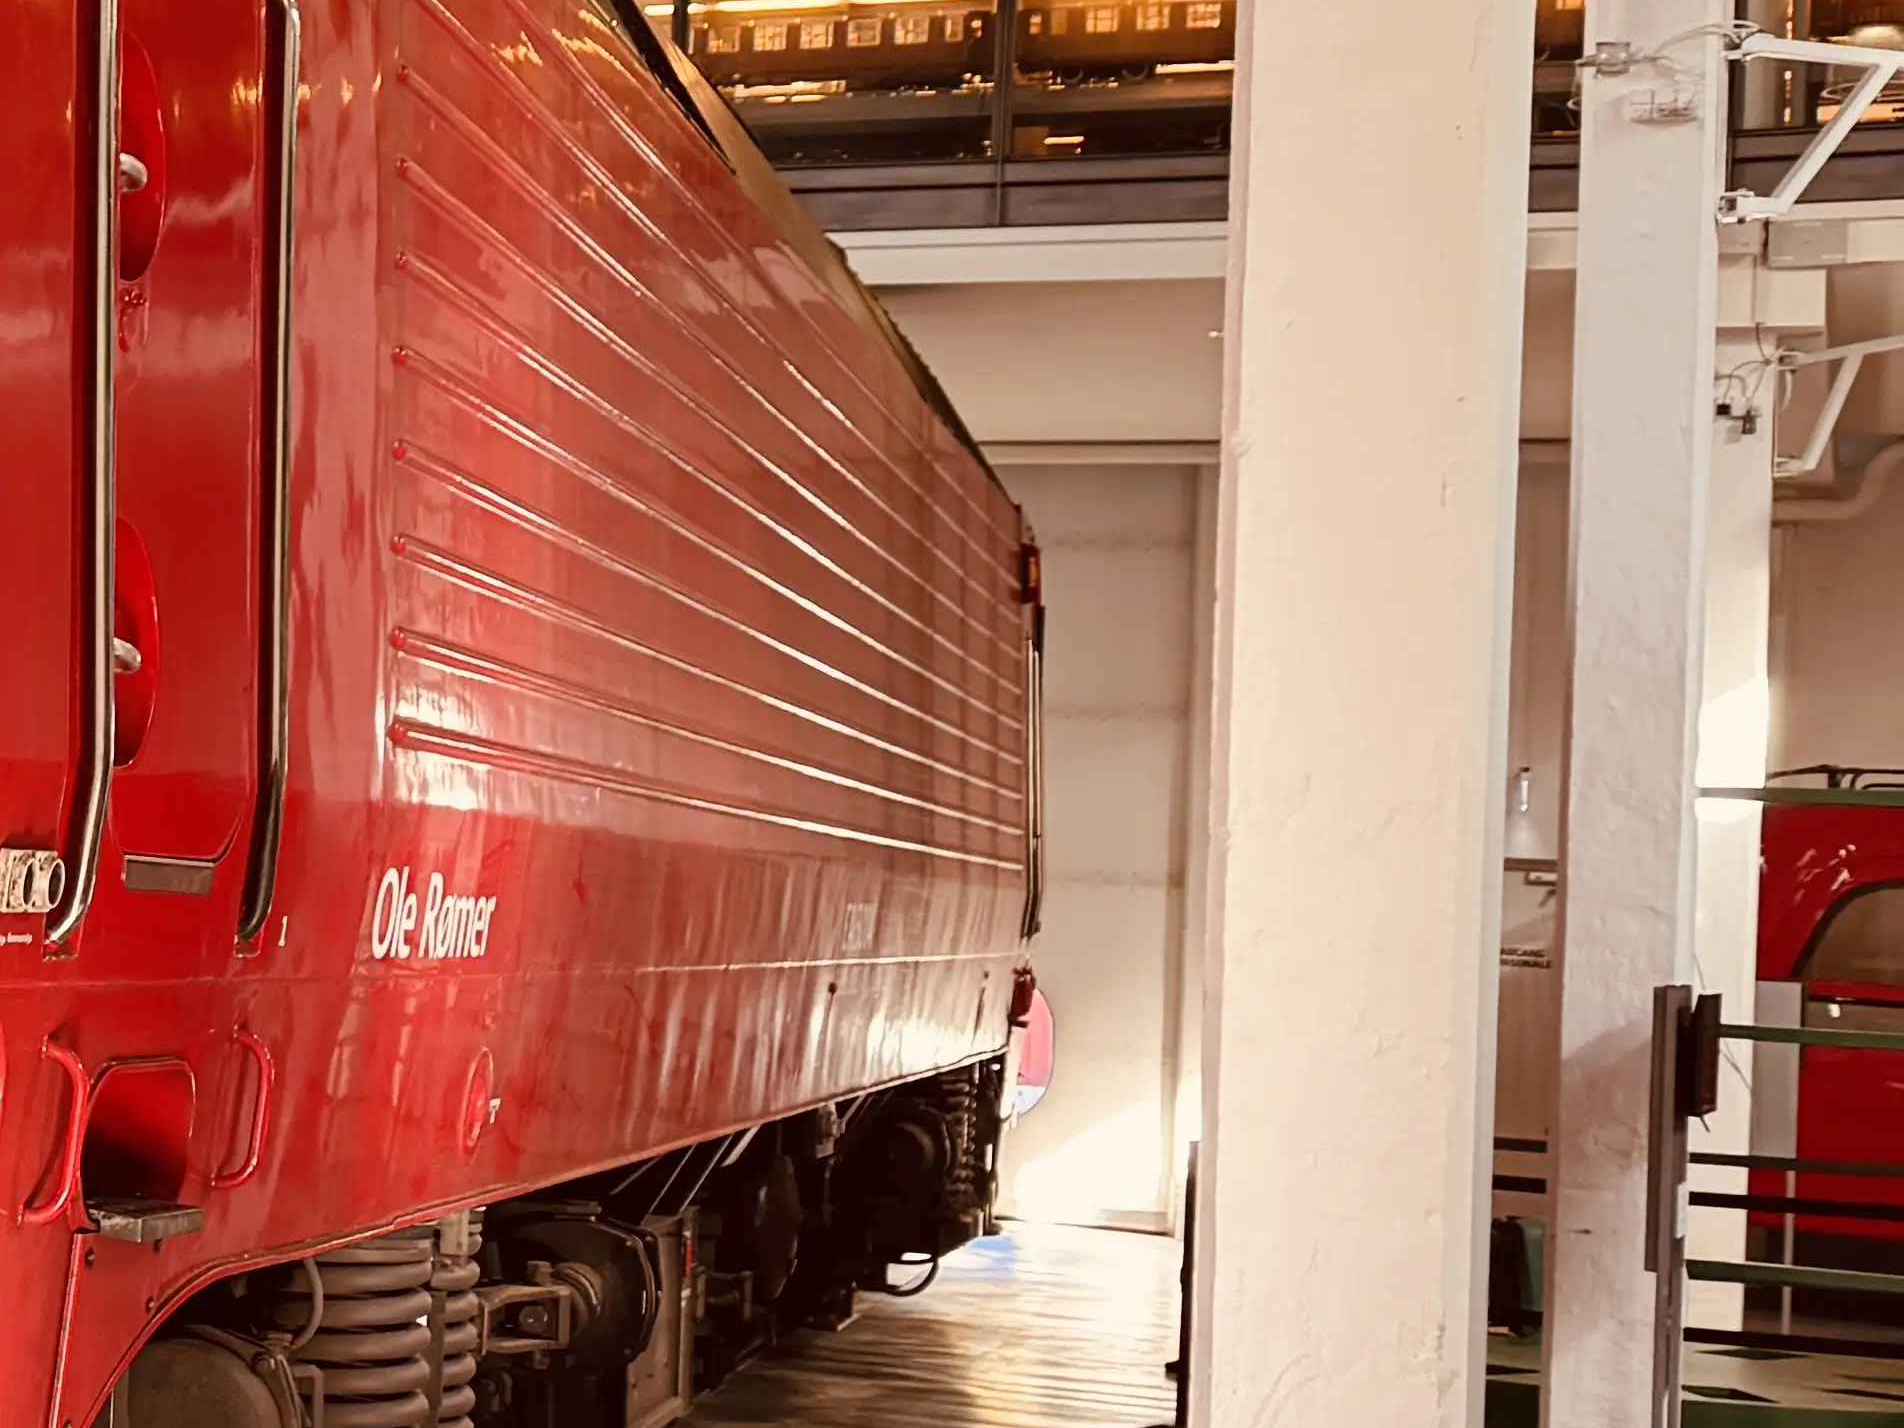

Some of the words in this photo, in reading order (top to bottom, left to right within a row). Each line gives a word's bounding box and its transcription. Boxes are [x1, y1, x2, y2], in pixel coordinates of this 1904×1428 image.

[278, 916, 288, 947] 1
[372, 866, 417, 959] Ole
[418, 872, 497, 960] Rømer
